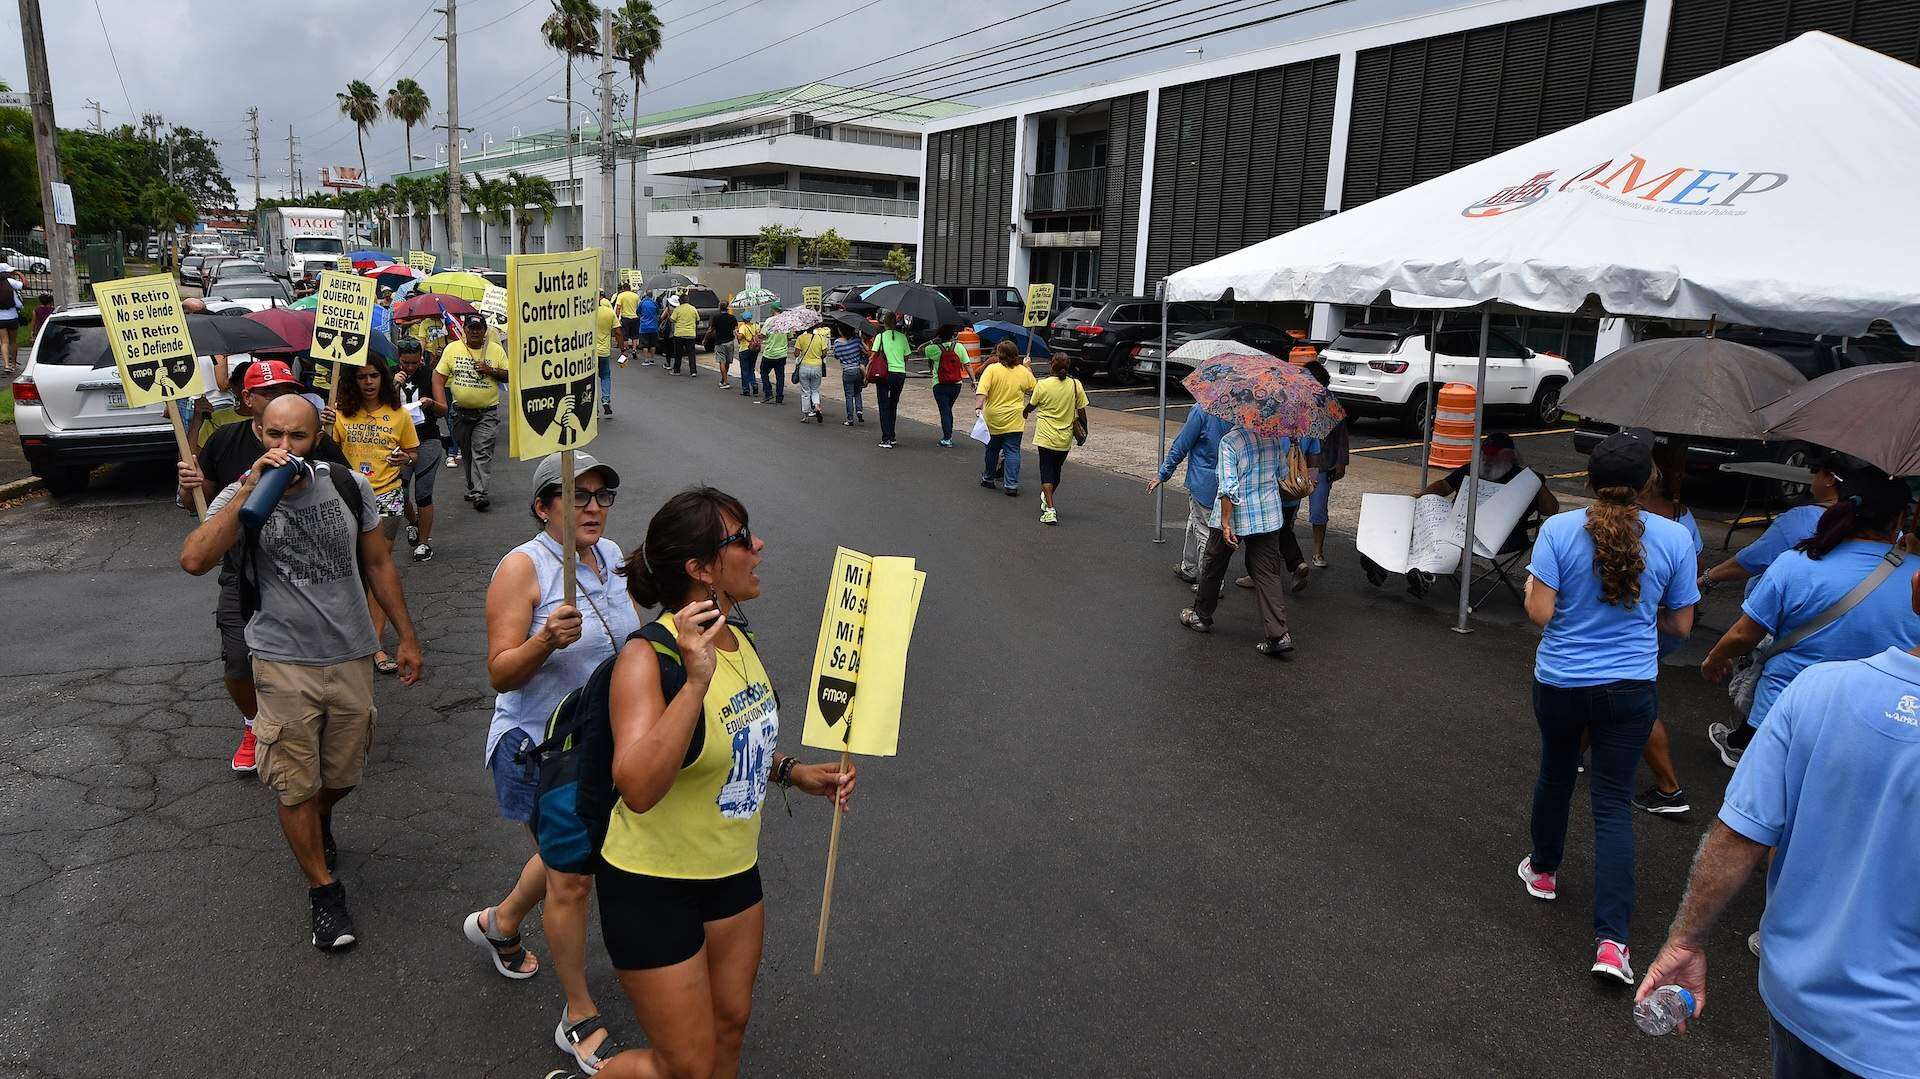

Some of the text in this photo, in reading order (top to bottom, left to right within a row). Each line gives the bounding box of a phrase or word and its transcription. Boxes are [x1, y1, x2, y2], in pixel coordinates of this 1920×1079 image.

[290, 218, 336, 228] MAGIC
[330, 278, 361, 292] ABIERTA
[534, 267, 588, 294] Junta de
[112, 290, 169, 307] Mi Retiro
[322, 289, 367, 306] QUIERO MI
[116, 303, 173, 323] No se Vende
[322, 305, 364, 320] ESCUELA
[522, 298, 570, 324] Control
[324, 316, 360, 331] ABIERTA
[122, 324, 179, 342] Mi Retiro
[127, 338, 184, 359] Se Defiende
[523, 330, 593, 363] ¡Dictadura
[527, 396, 555, 413] FMPR
[296, 498, 340, 517] YOUR MIND
[333, 527, 349, 537] CUP
[845, 564, 862, 584] Mi
[840, 587, 856, 611] No
[836, 620, 854, 642] Mi
[830, 645, 847, 669] Se
[822, 687, 847, 704] FMPR
